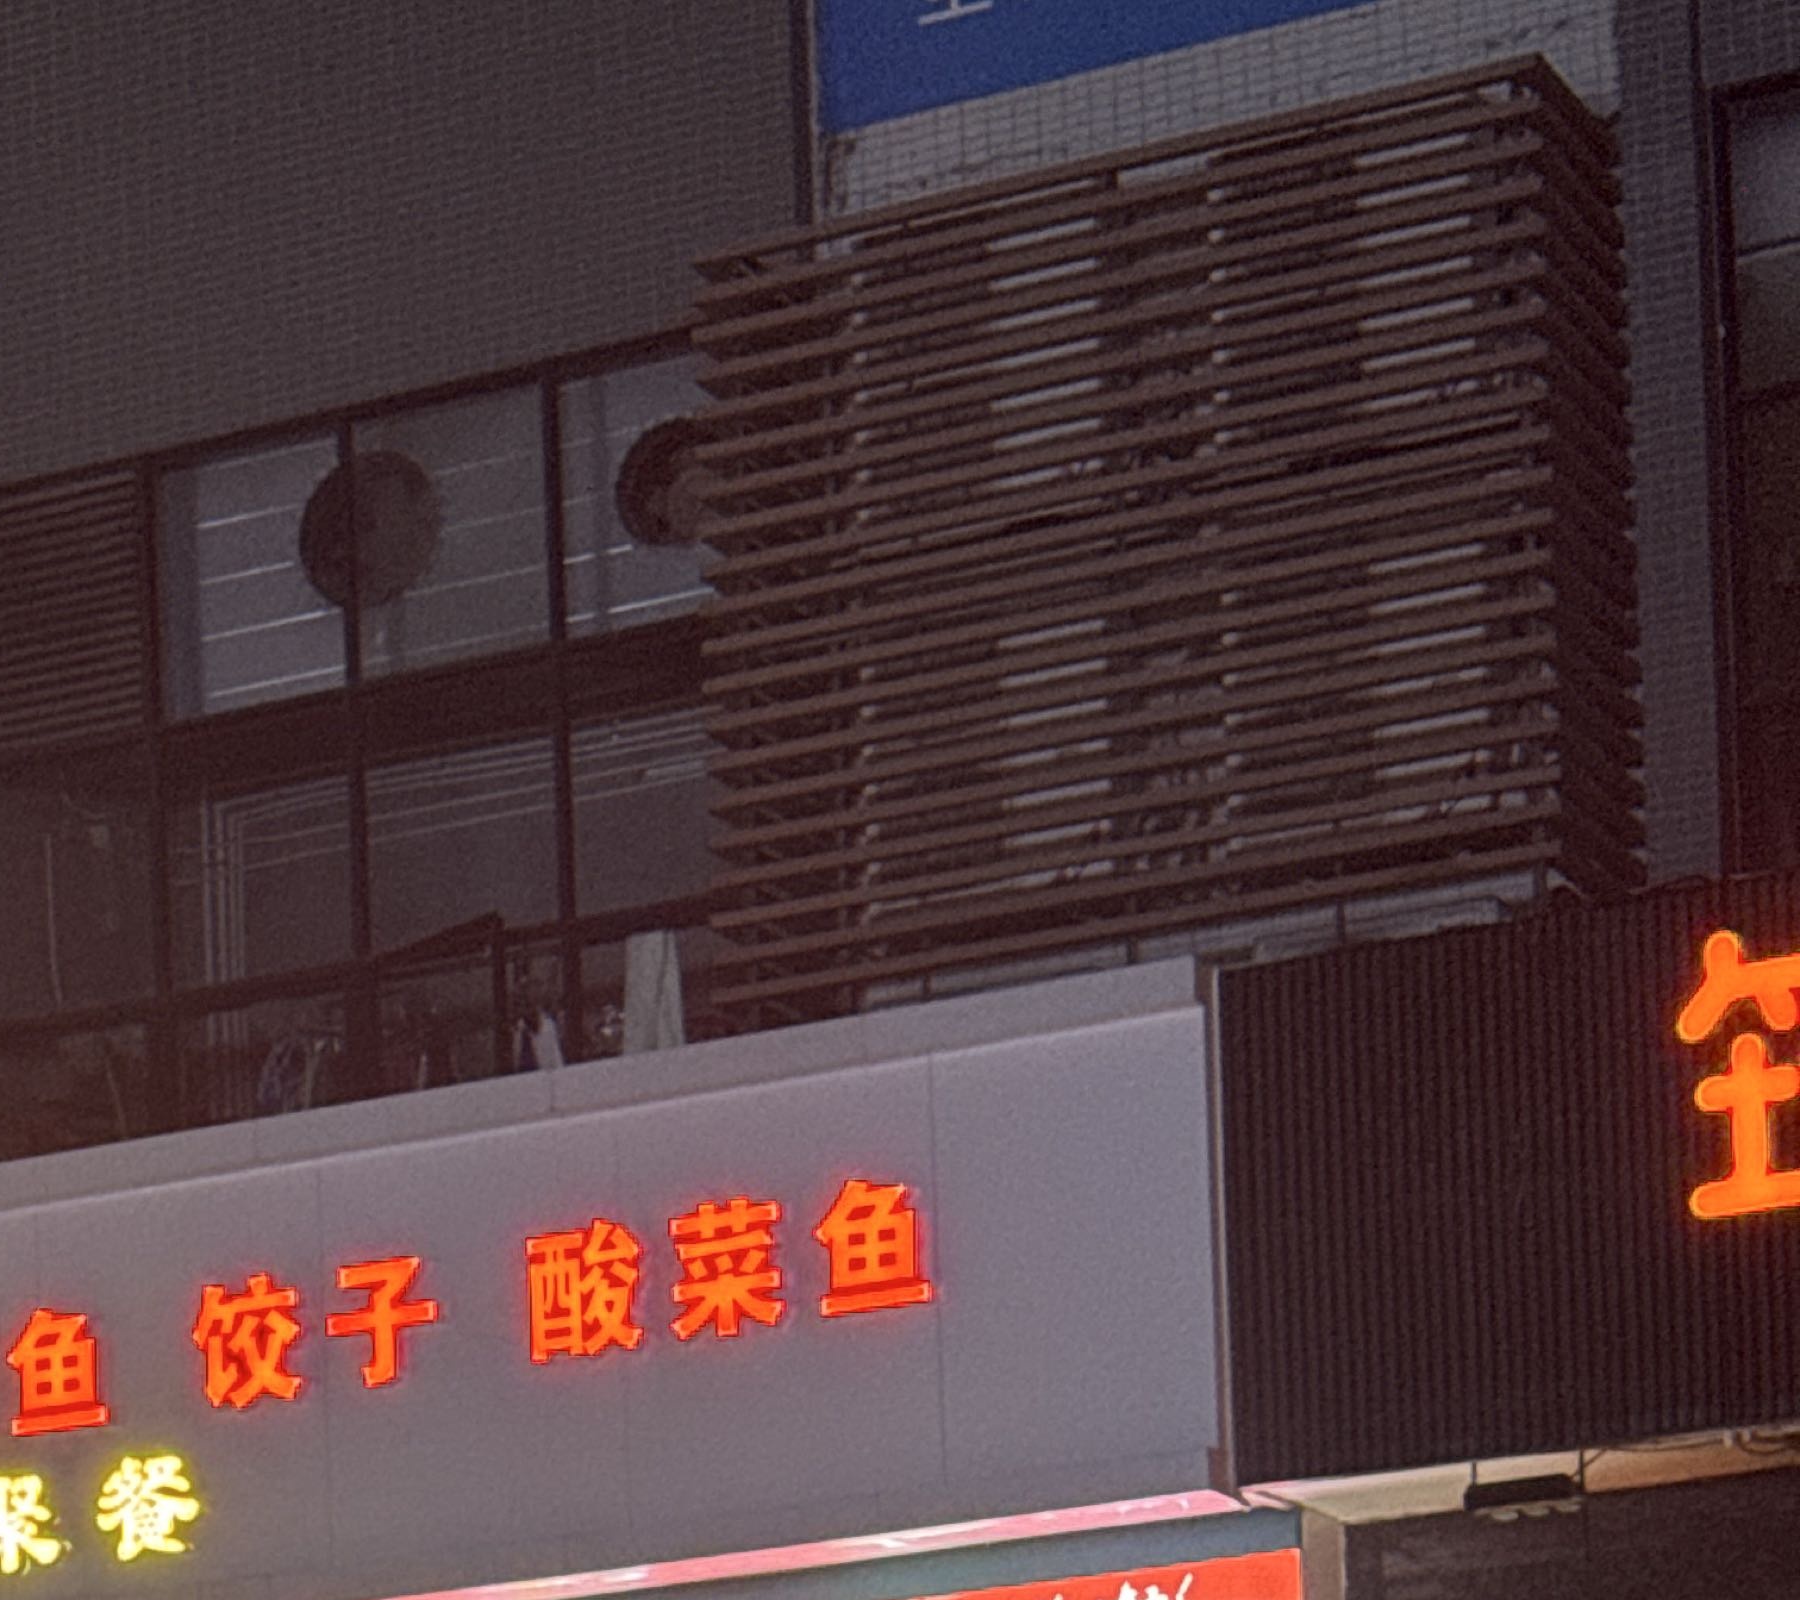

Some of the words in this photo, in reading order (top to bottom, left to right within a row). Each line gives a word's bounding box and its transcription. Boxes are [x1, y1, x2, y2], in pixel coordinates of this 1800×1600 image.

[193, 1258, 437, 1408] 饺子
[526, 1181, 932, 1363] 酸菜鱼
